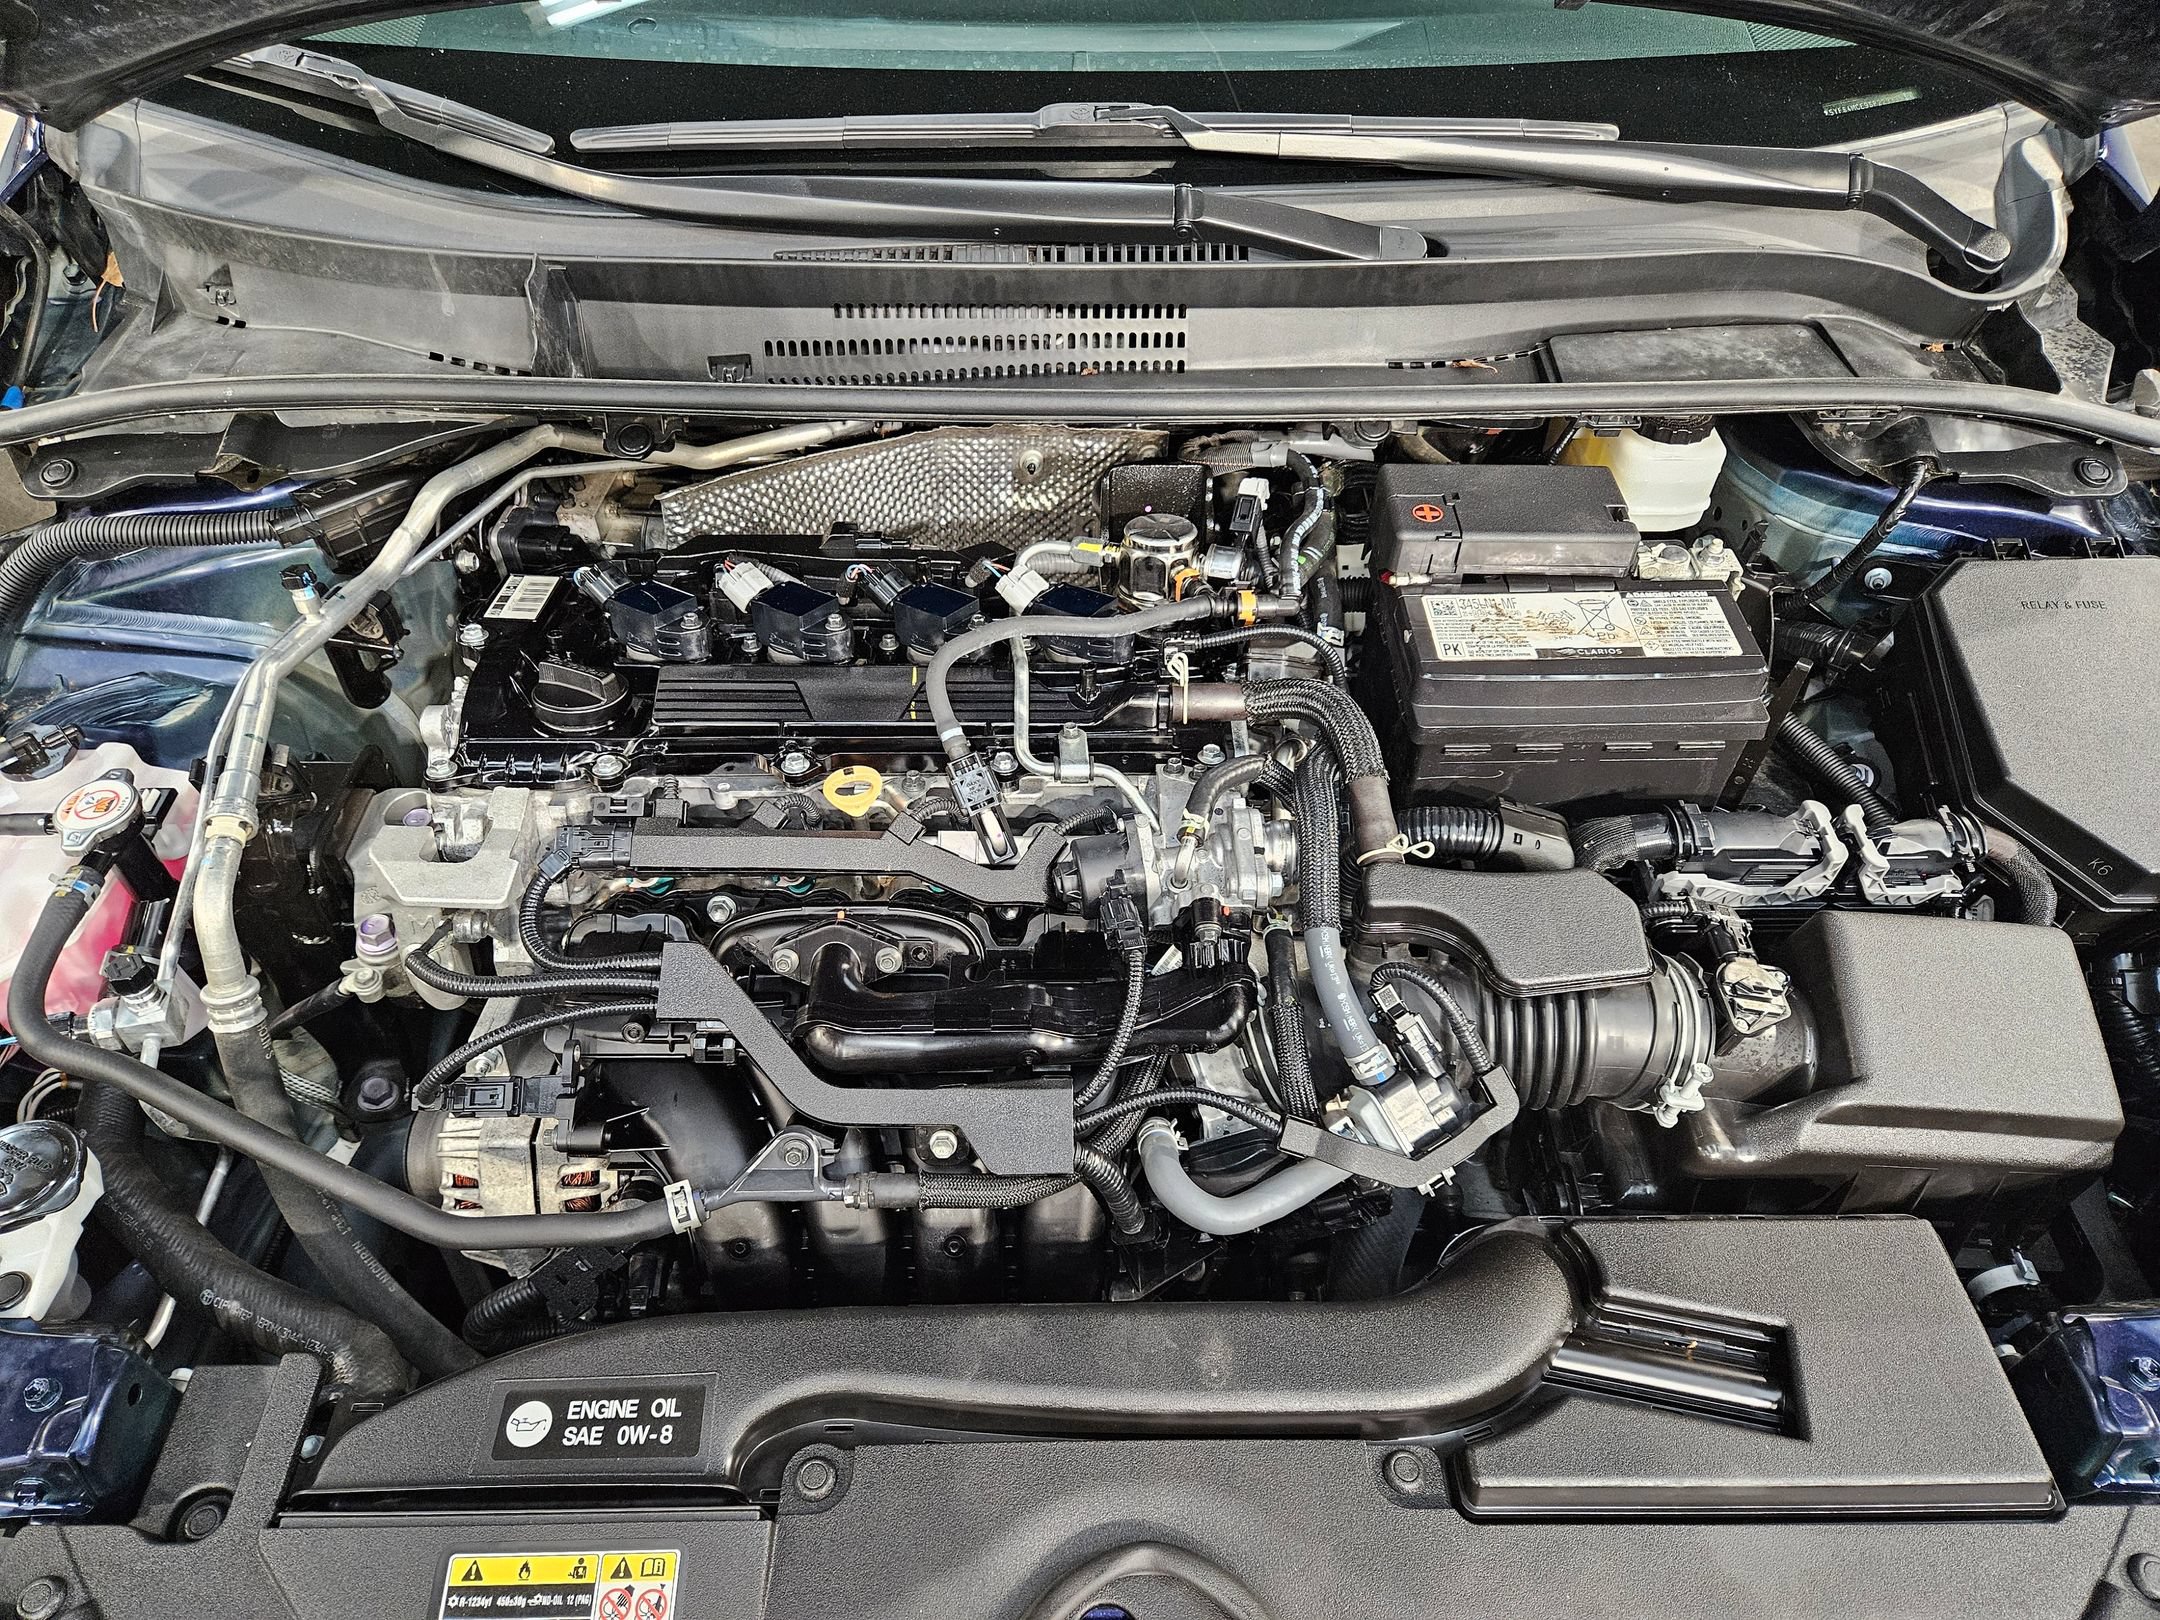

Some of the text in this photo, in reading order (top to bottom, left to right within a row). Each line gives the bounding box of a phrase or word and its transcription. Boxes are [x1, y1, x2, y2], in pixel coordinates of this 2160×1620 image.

[2020, 600, 2107, 610] RELAY & FUSE
[1443, 643, 1463, 656] PK
[567, 1398, 682, 1420] ENGINE OIL
[562, 1426, 605, 1446] SAE
[566, 1594, 574, 1605] 12
